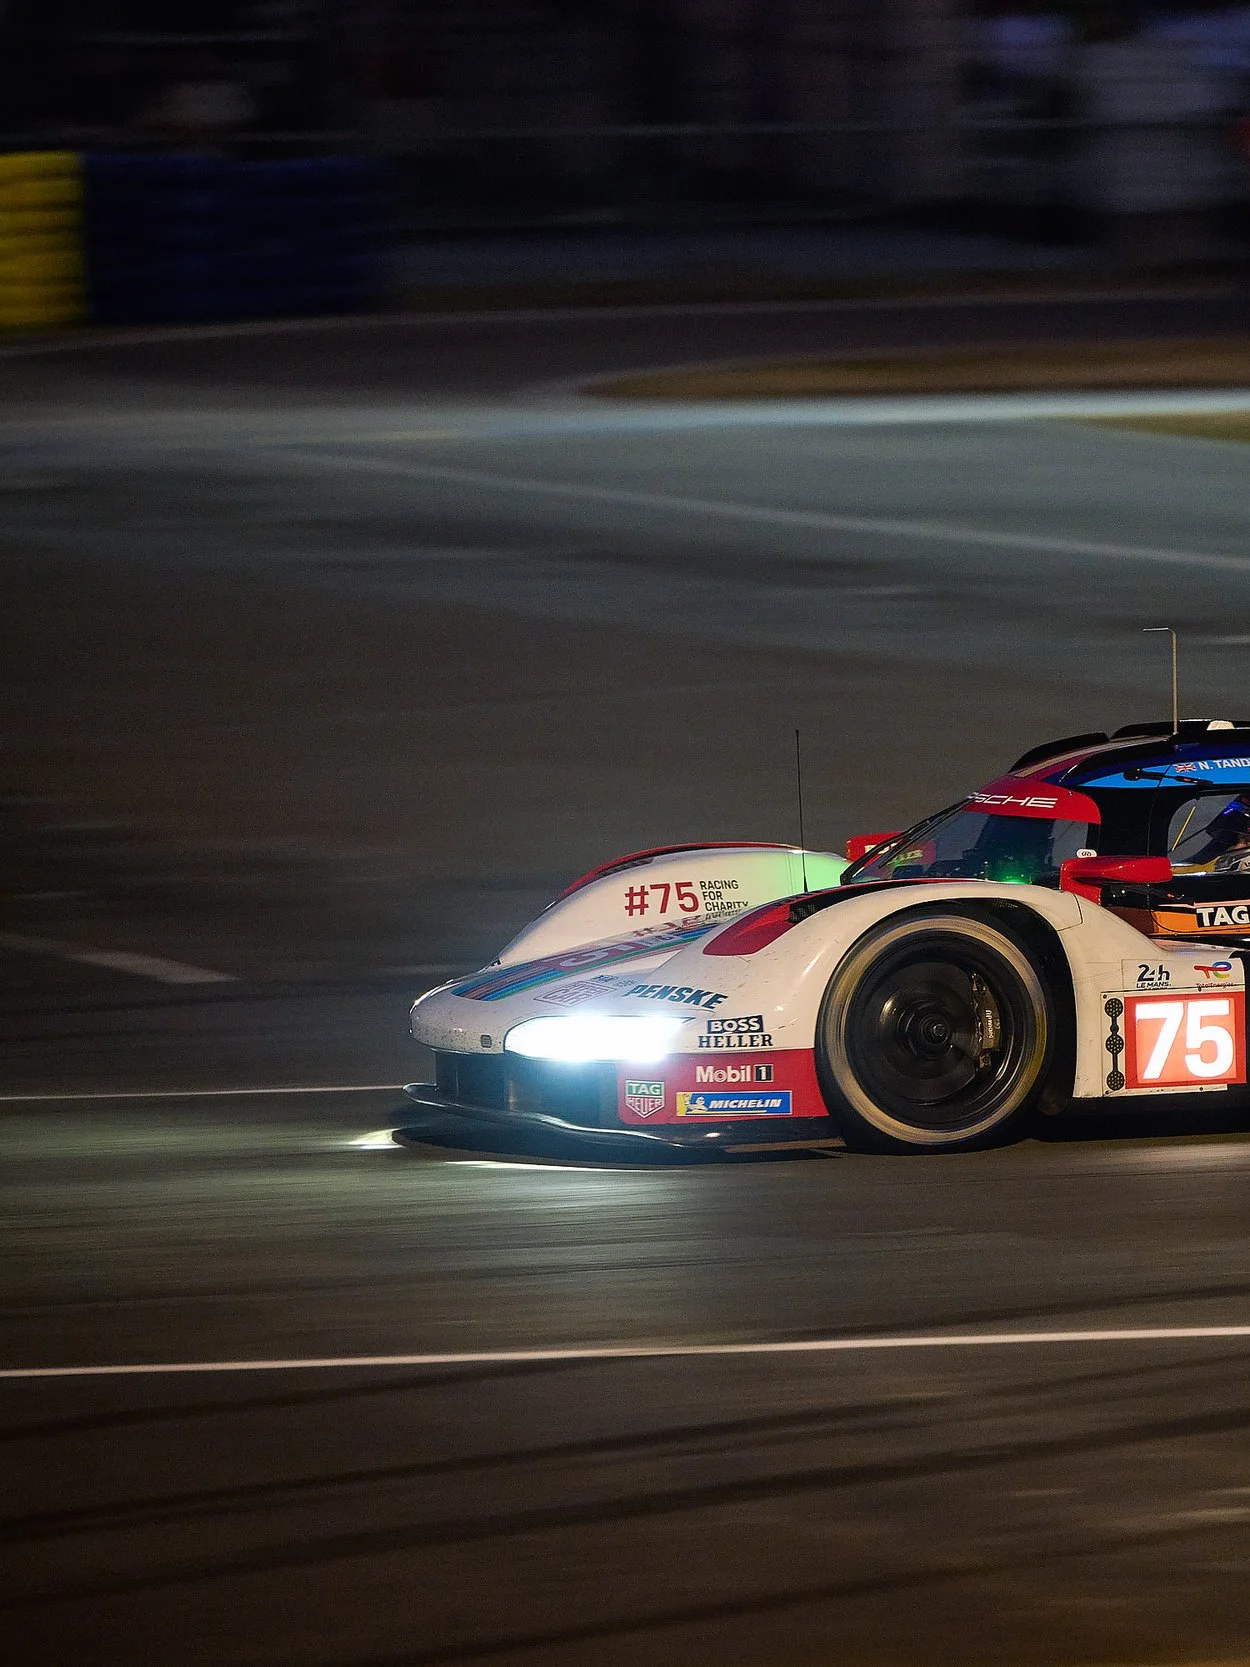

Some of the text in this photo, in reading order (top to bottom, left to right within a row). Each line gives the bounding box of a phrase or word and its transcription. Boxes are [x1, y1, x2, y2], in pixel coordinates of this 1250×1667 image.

[1198, 761, 1214, 770] N.
[700, 880, 739, 890] RACING
[624, 882, 699, 916] #75
[702, 890, 723, 900] FOR
[705, 901, 749, 911] CHARITY
[623, 984, 728, 1009] PENSKE
[711, 1017, 761, 1032] BOSS
[698, 1034, 773, 1048] HELLER
[1135, 999, 1234, 1080] 75
[696, 1065, 751, 1082] Mobil
[630, 1082, 662, 1095] TAG
[627, 1098, 662, 1114] HEUER
[709, 1098, 782, 1109] MICHELIN
